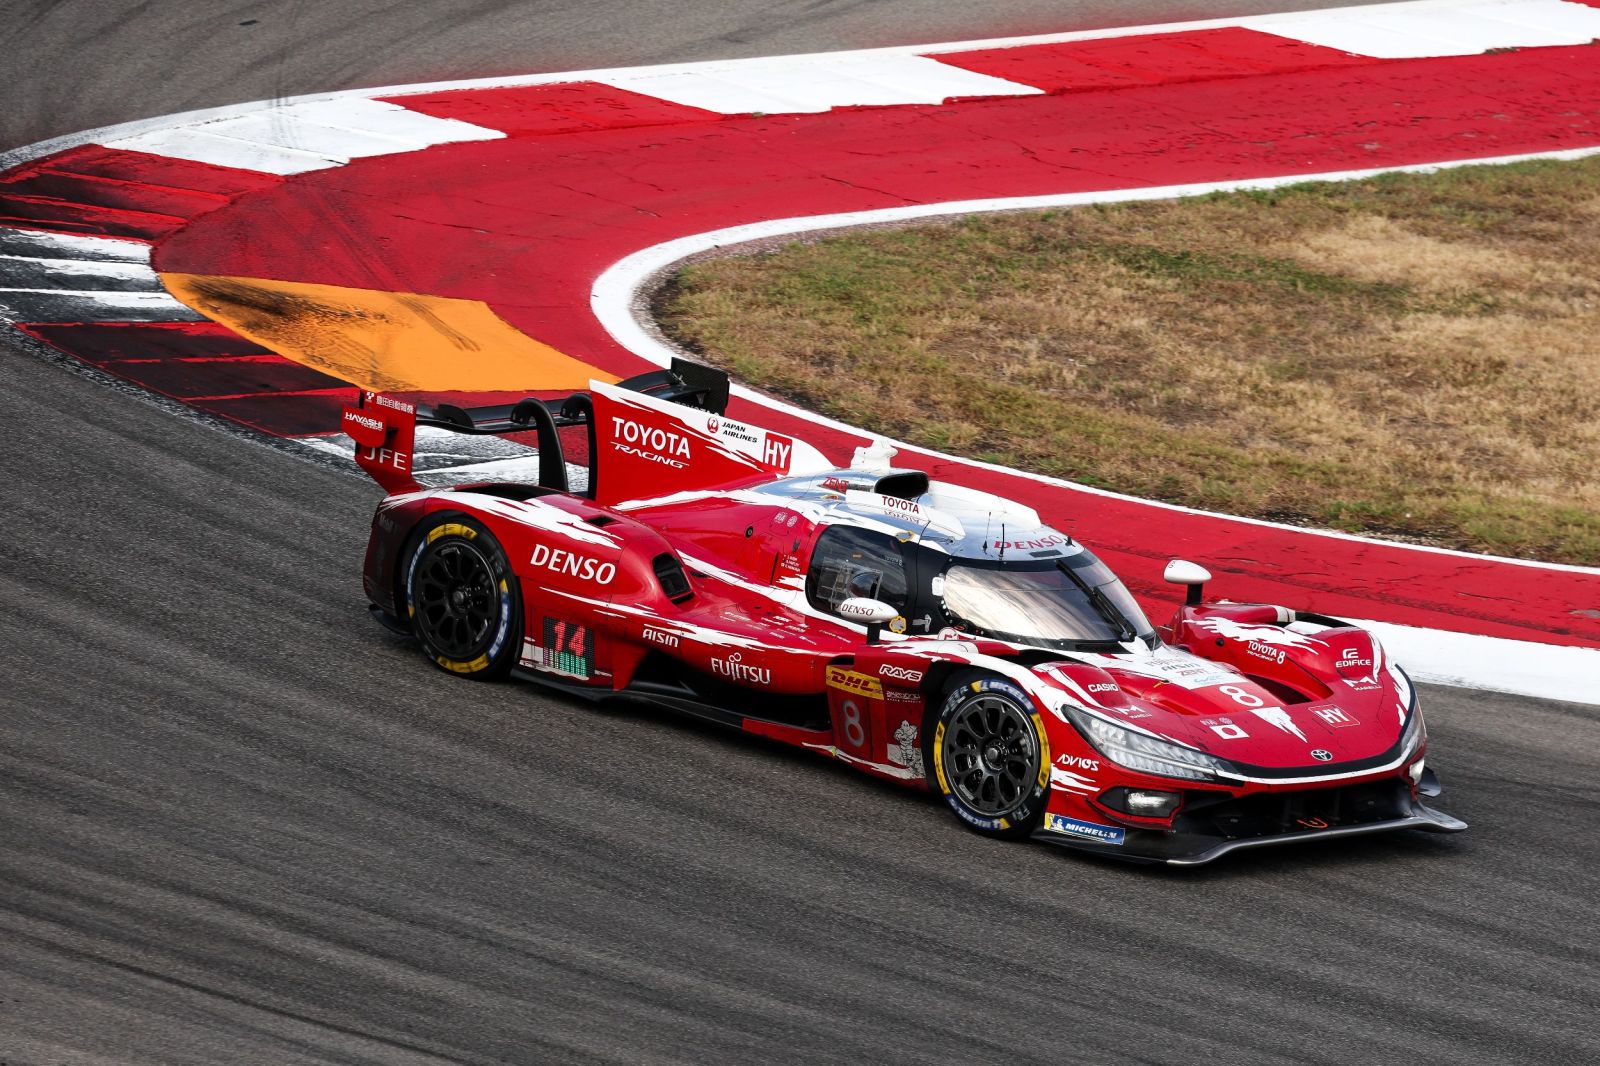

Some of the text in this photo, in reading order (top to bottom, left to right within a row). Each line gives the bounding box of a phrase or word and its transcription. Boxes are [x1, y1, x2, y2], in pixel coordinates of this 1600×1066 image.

[345, 412, 383, 429] HAYASHI
[722, 422, 746, 432] JAPAN
[612, 416, 691, 459] TOYOTA
[722, 430, 758, 443] AIRLINES
[364, 446, 407, 471] JFE
[611, 441, 689, 469] RACING
[764, 439, 790, 468] HY
[882, 496, 919, 514] TOYOTA
[994, 535, 1063, 549] DENSO
[530, 543, 616, 585] DENSO
[841, 604, 874, 616] DENSO
[554, 621, 588, 656] 14
[642, 628, 679, 648] AISIN
[1248, 640, 1286, 665] TOYOTA 8
[710, 652, 771, 684] FUJITSU
[879, 663, 923, 682] RAYS
[1335, 659, 1372, 668] EDIFICE
[831, 670, 876, 693] DHL
[1087, 683, 1120, 693] CASIO
[1219, 685, 1264, 707] 8
[843, 700, 865, 748] 8
[1314, 707, 1351, 724] HY
[1065, 823, 1118, 839] MICHELIN
